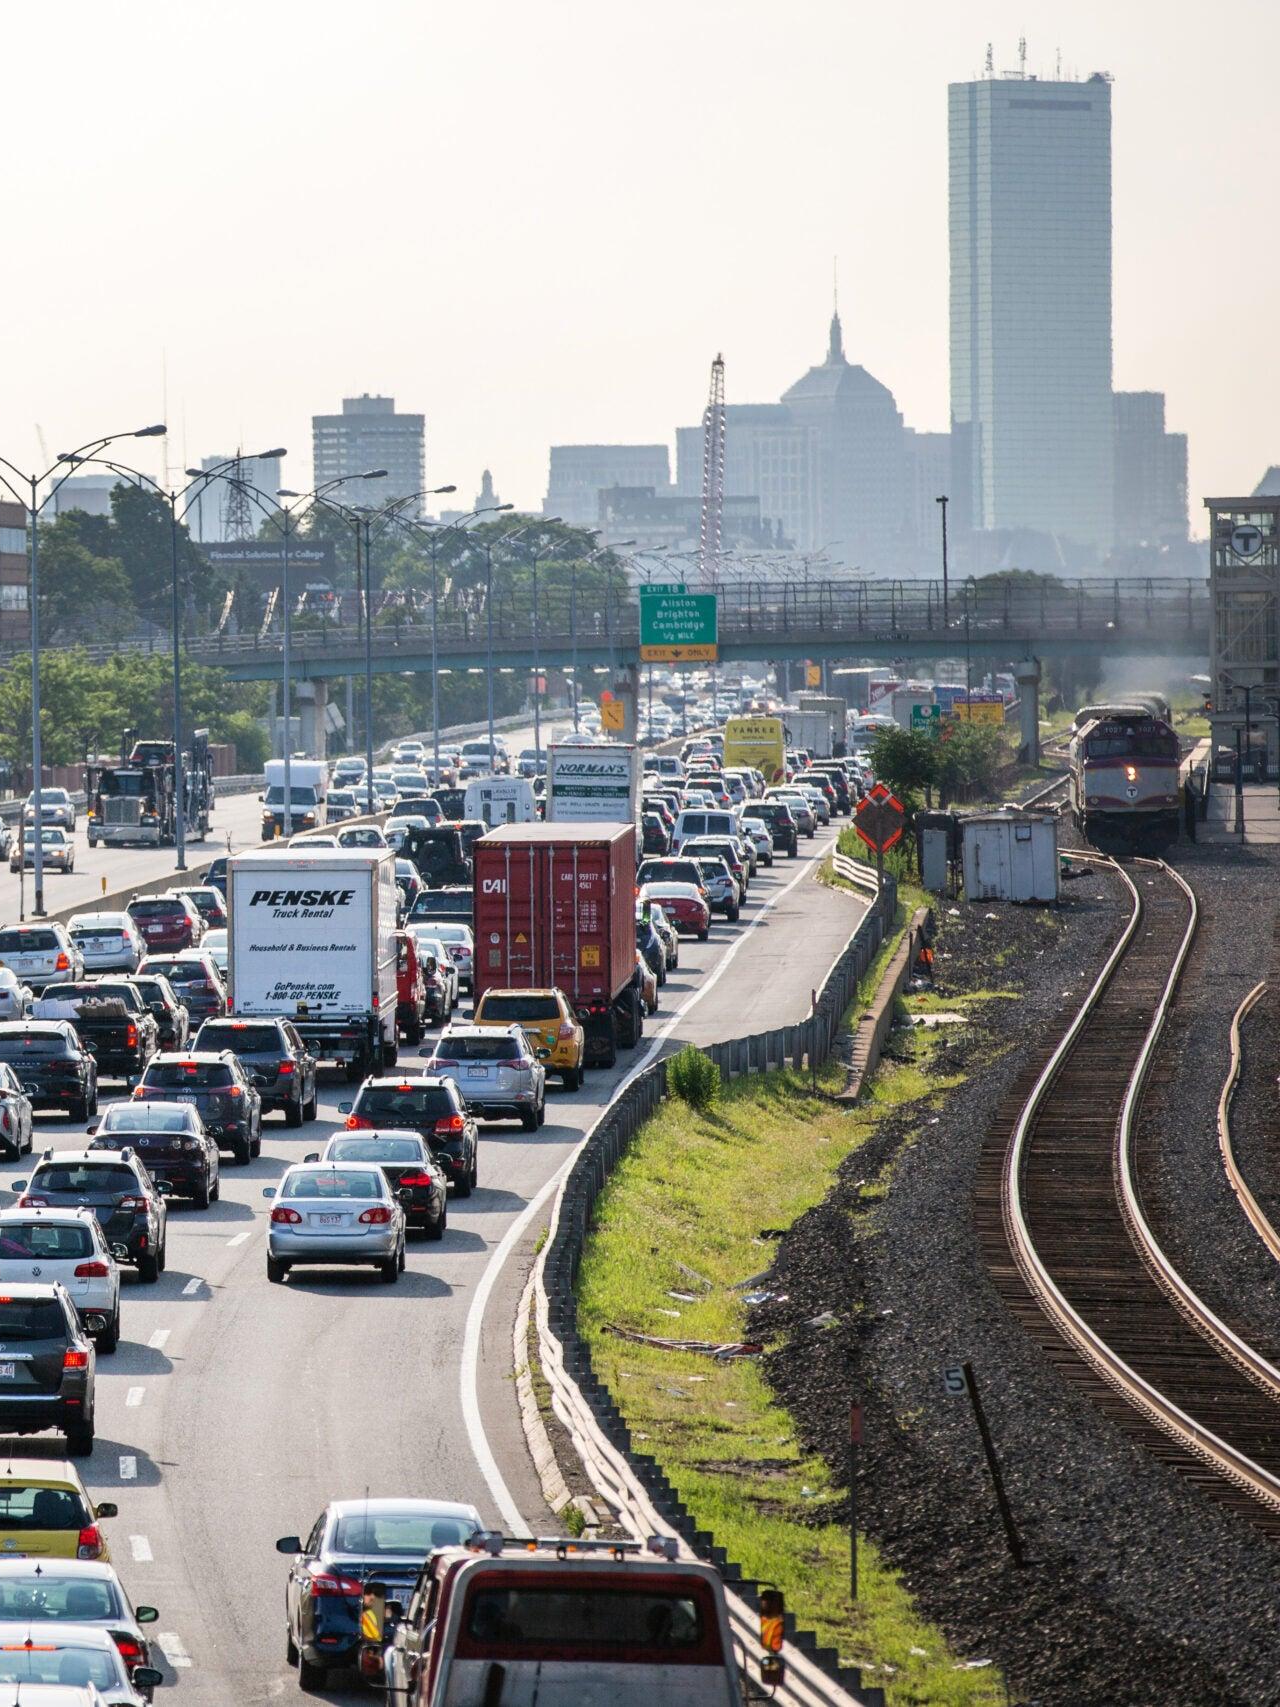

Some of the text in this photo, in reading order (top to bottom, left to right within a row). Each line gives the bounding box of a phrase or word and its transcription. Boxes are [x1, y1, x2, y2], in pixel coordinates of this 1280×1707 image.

[1235, 532, 1258, 552] T
[210, 549, 325, 560] Financial Solutions fr College
[646, 585, 679, 593] EXIT 18
[660, 599, 697, 607] Allston
[656, 610, 700, 620] Brighton
[652, 620, 705, 631] Cambridge
[677, 632, 695, 640] MILE
[732, 726, 775, 734] YANKEE
[556, 763, 627, 774] NORMAN'S
[578, 873, 598, 881] 959177
[482, 879, 506, 893] CAI
[249, 889, 356, 906] PENSKE
[272, 908, 334, 918] Truck Rental
[249, 943, 357, 952] Household & Business Rentals
[274, 982, 335, 991] GoPenske.com
[265, 991, 341, 1000] 1-800-GO-PENSKE
[945, 1368, 965, 1392] 5
